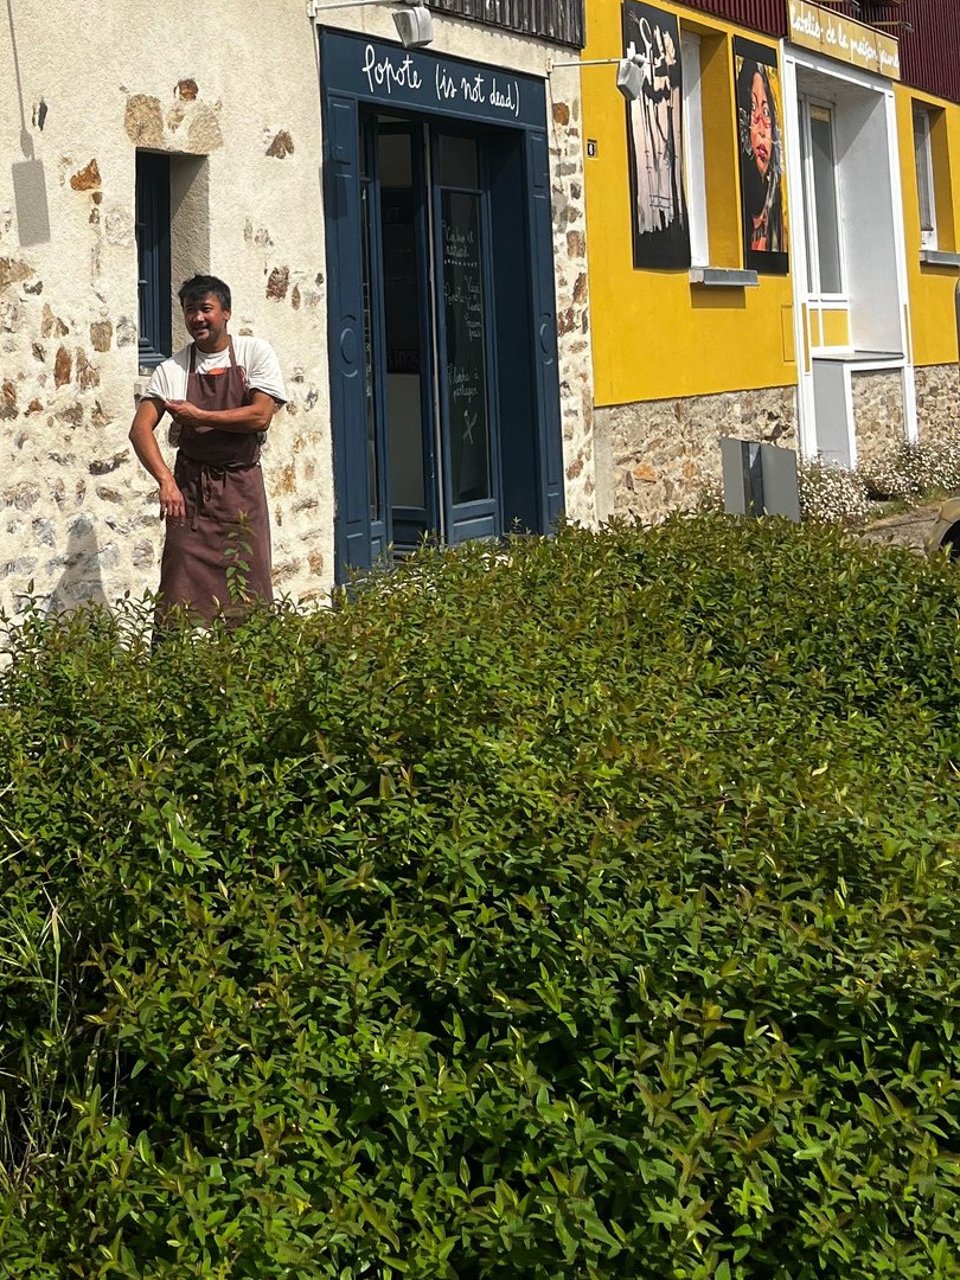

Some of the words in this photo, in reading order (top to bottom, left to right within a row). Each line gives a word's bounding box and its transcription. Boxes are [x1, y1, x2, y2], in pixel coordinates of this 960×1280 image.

[362, 44, 423, 94] Popote
[435, 63, 458, 100] (is
[460, 73, 486, 103] not
[489, 77, 520, 117] dead)
